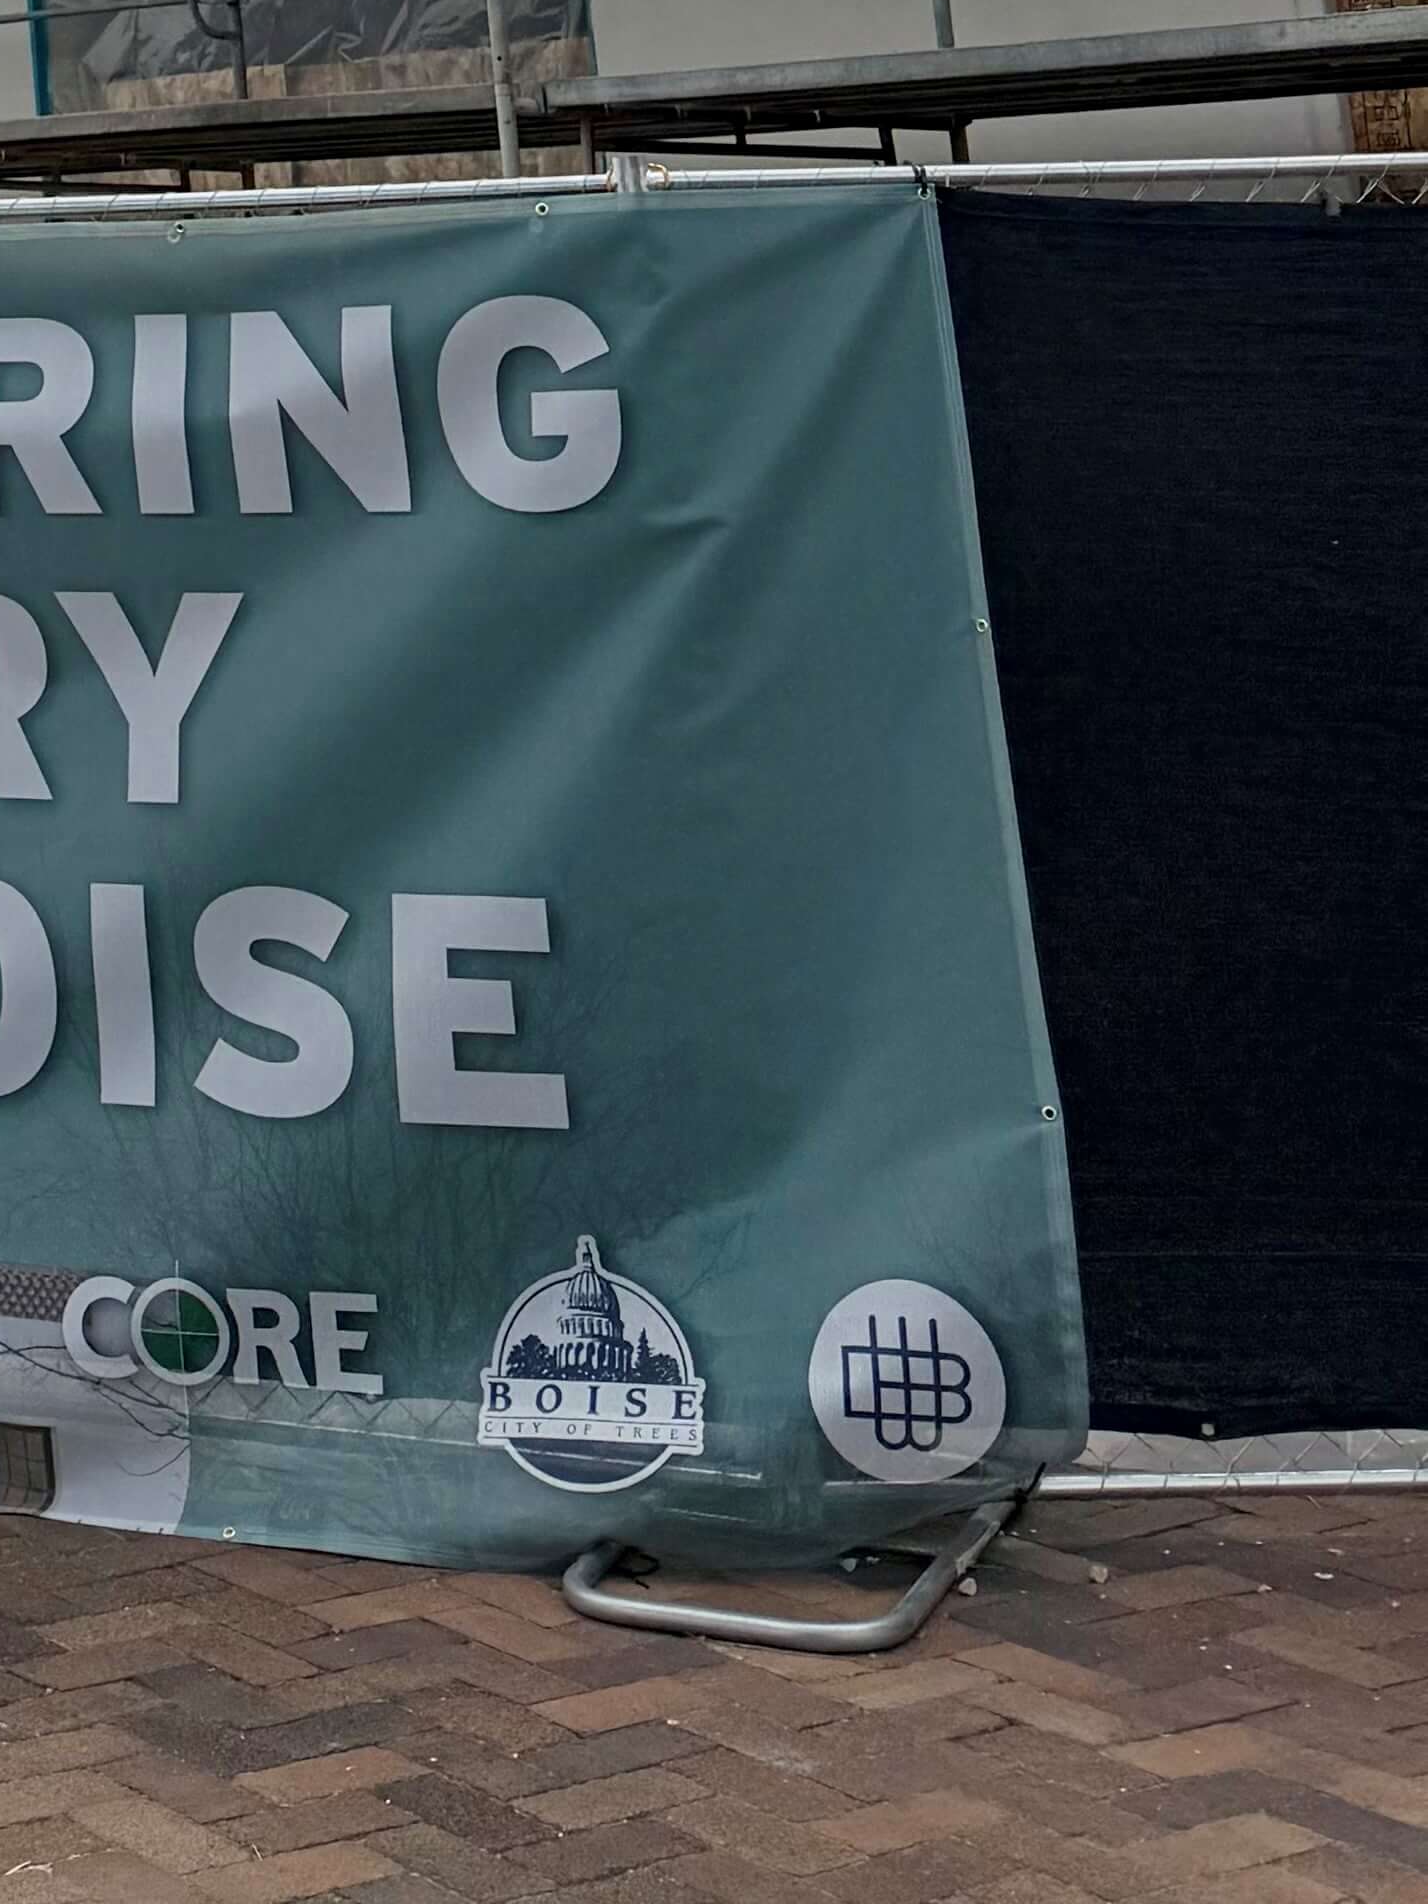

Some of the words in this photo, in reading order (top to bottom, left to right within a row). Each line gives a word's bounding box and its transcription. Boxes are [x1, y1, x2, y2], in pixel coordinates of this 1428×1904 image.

[62, 1275, 384, 1395] CORE
[487, 1380, 697, 1420] BOISE
[484, 1422, 543, 1434] CITY
[567, 1424, 592, 1436] OF
[616, 1425, 698, 1441] TREES
